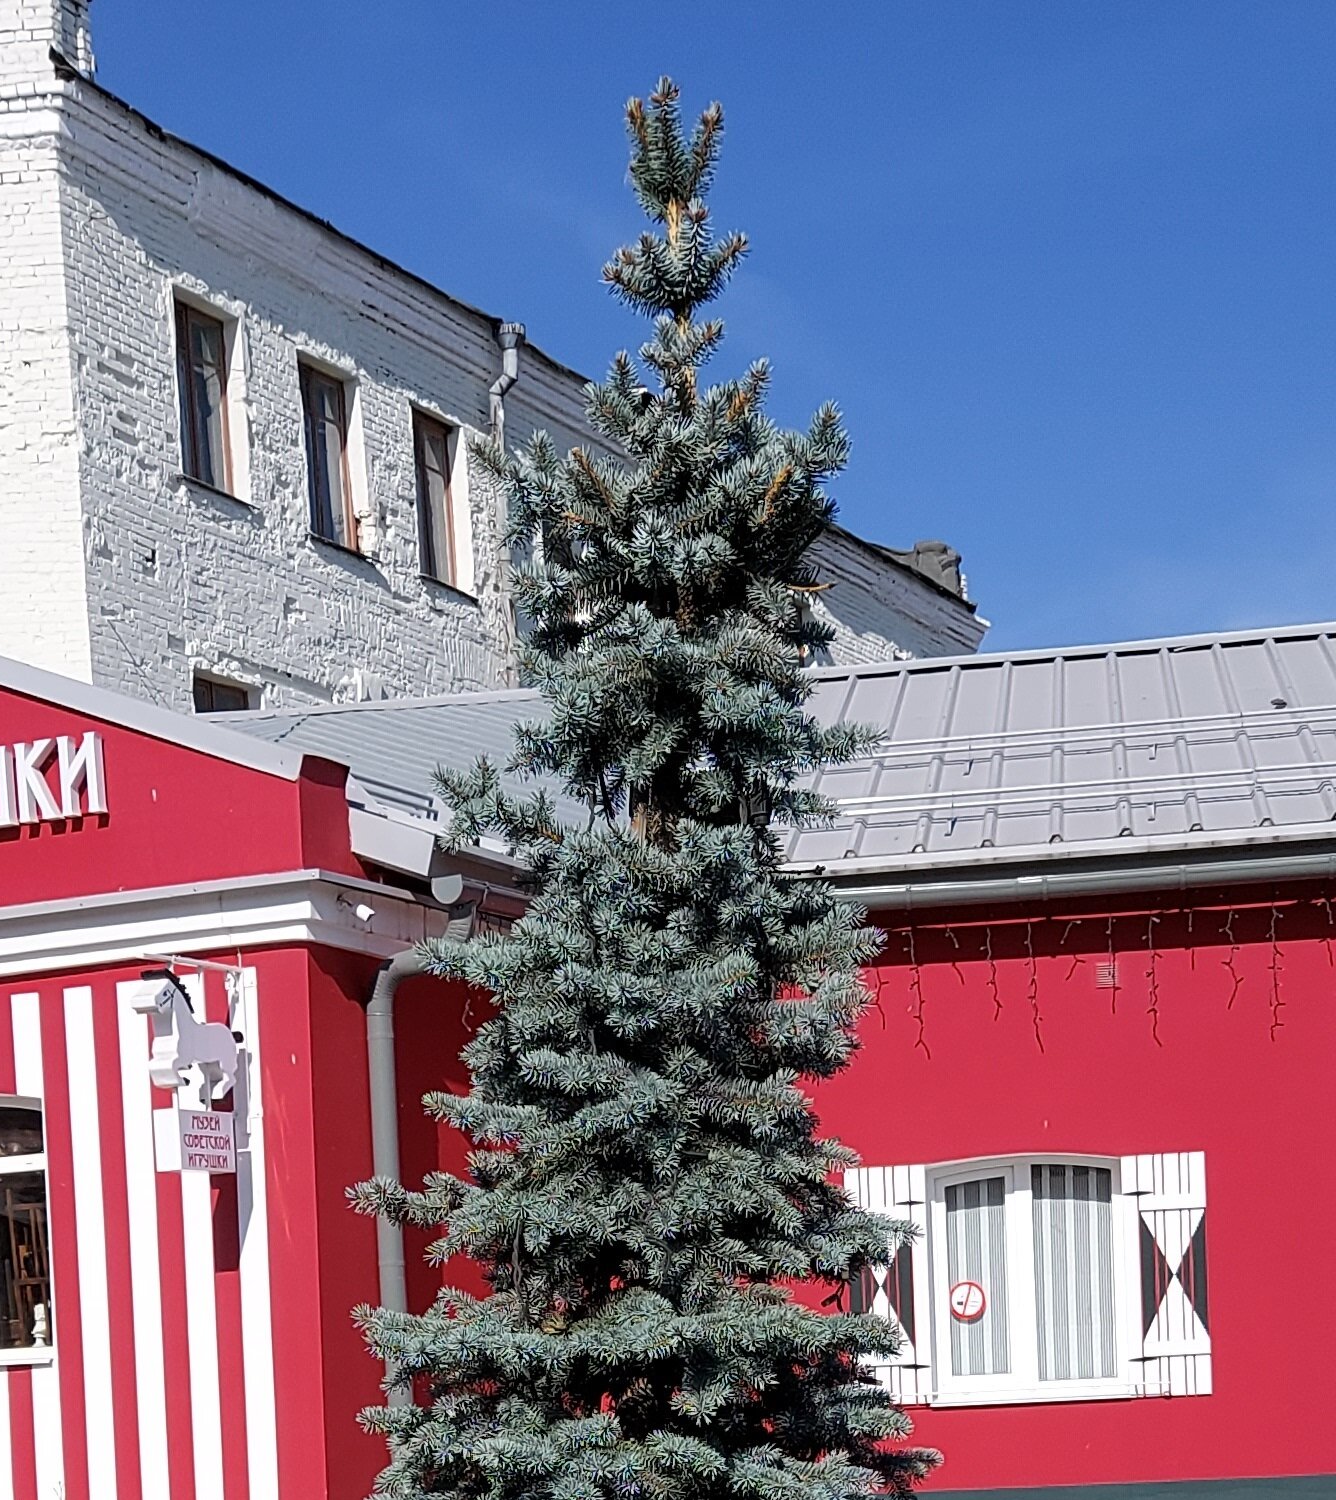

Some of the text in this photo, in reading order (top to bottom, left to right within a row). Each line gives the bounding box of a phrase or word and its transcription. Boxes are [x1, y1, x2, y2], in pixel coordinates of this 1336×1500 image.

[191, 1115, 221, 1131] МУЗЕЙ
[183, 1133, 231, 1151] СОВЕТСКОЙ
[188, 1153, 229, 1169] ИГРУШКИ
